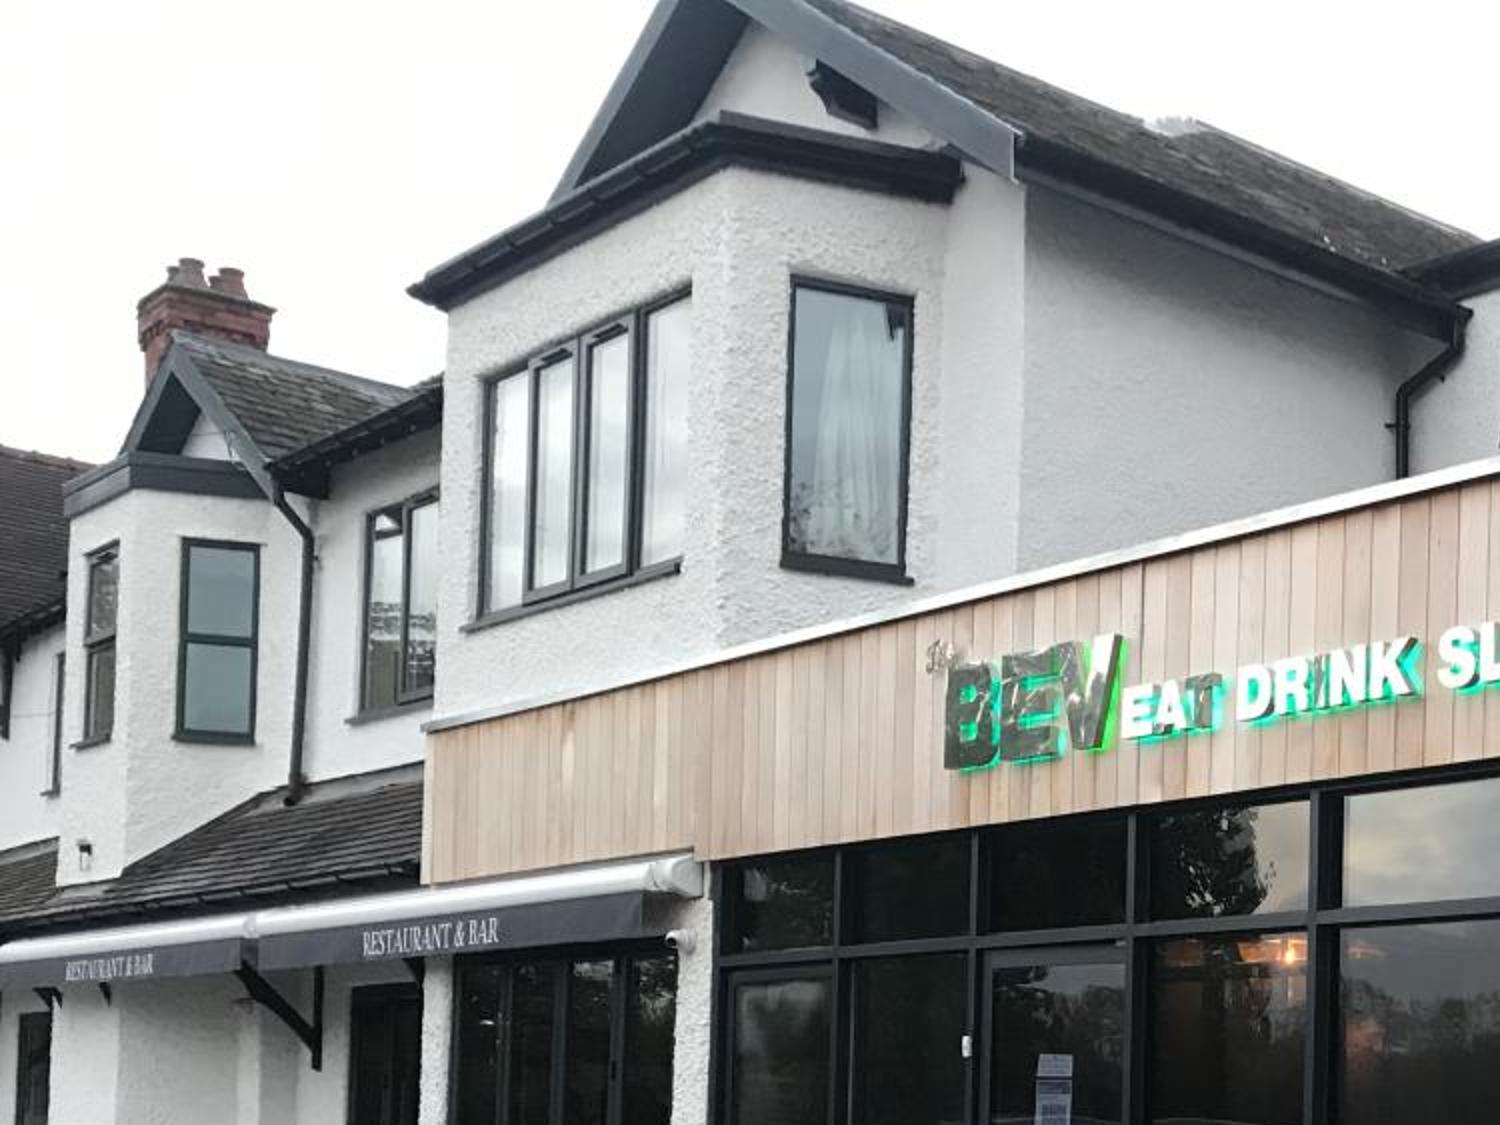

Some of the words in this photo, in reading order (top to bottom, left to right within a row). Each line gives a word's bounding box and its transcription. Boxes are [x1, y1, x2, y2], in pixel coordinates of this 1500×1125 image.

[1120, 672, 1224, 740] EAT
[1236, 635, 1419, 723] DRINK
[363, 922, 452, 957] RESTAURANT
[454, 920, 465, 947] &
[469, 917, 499, 945] BAR
